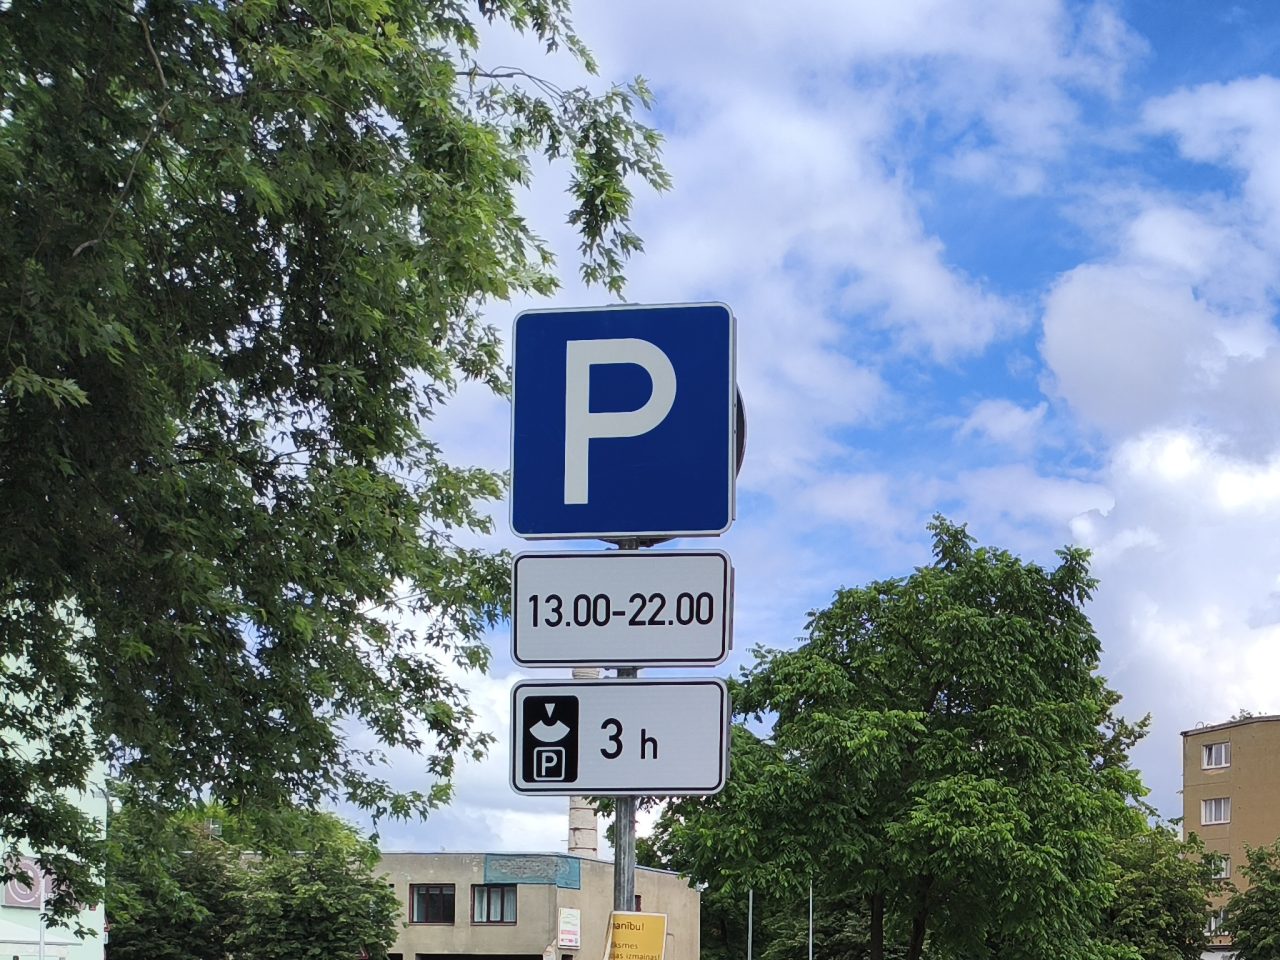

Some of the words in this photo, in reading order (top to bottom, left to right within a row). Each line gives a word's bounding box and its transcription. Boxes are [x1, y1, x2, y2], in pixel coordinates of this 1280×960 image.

[564, 338, 677, 504] P
[528, 592, 714, 627] 13.00-22.00
[600, 718, 623, 759] 3
[641, 728, 657, 759] h
[541, 752, 558, 776] P
